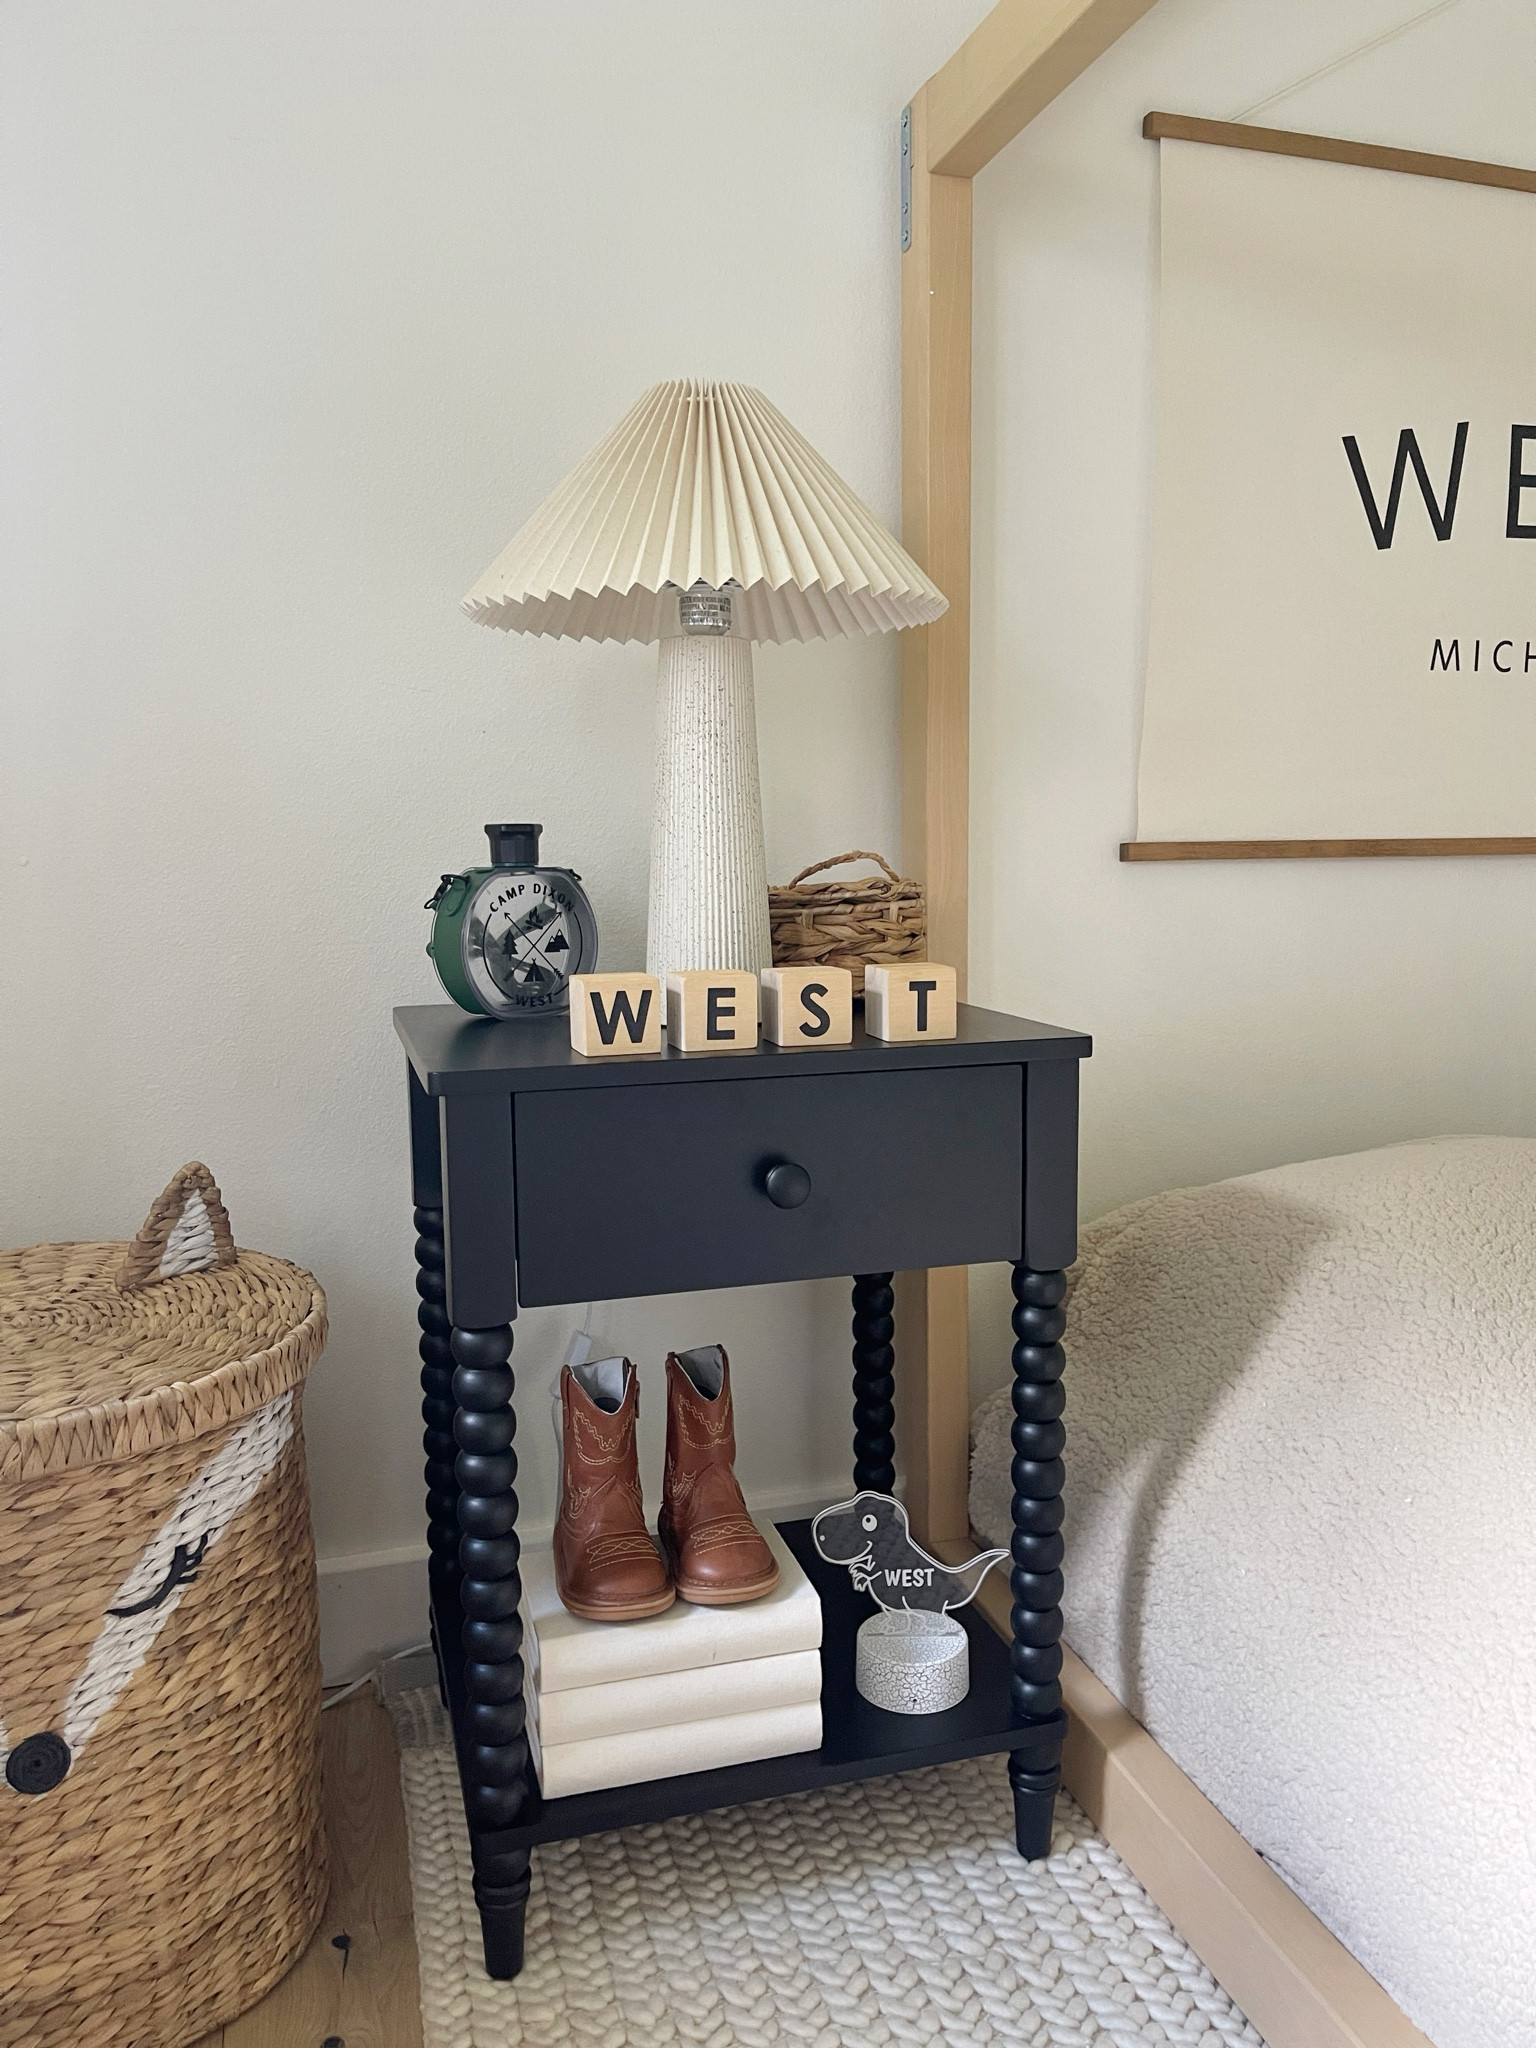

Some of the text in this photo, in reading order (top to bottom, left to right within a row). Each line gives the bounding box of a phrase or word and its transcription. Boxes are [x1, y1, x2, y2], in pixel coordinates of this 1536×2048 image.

[489, 883, 575, 913] CAMP DIXON
[515, 993, 553, 1008] WEST
[590, 981, 936, 1046] WEST
[884, 1567, 935, 1588] WEST
